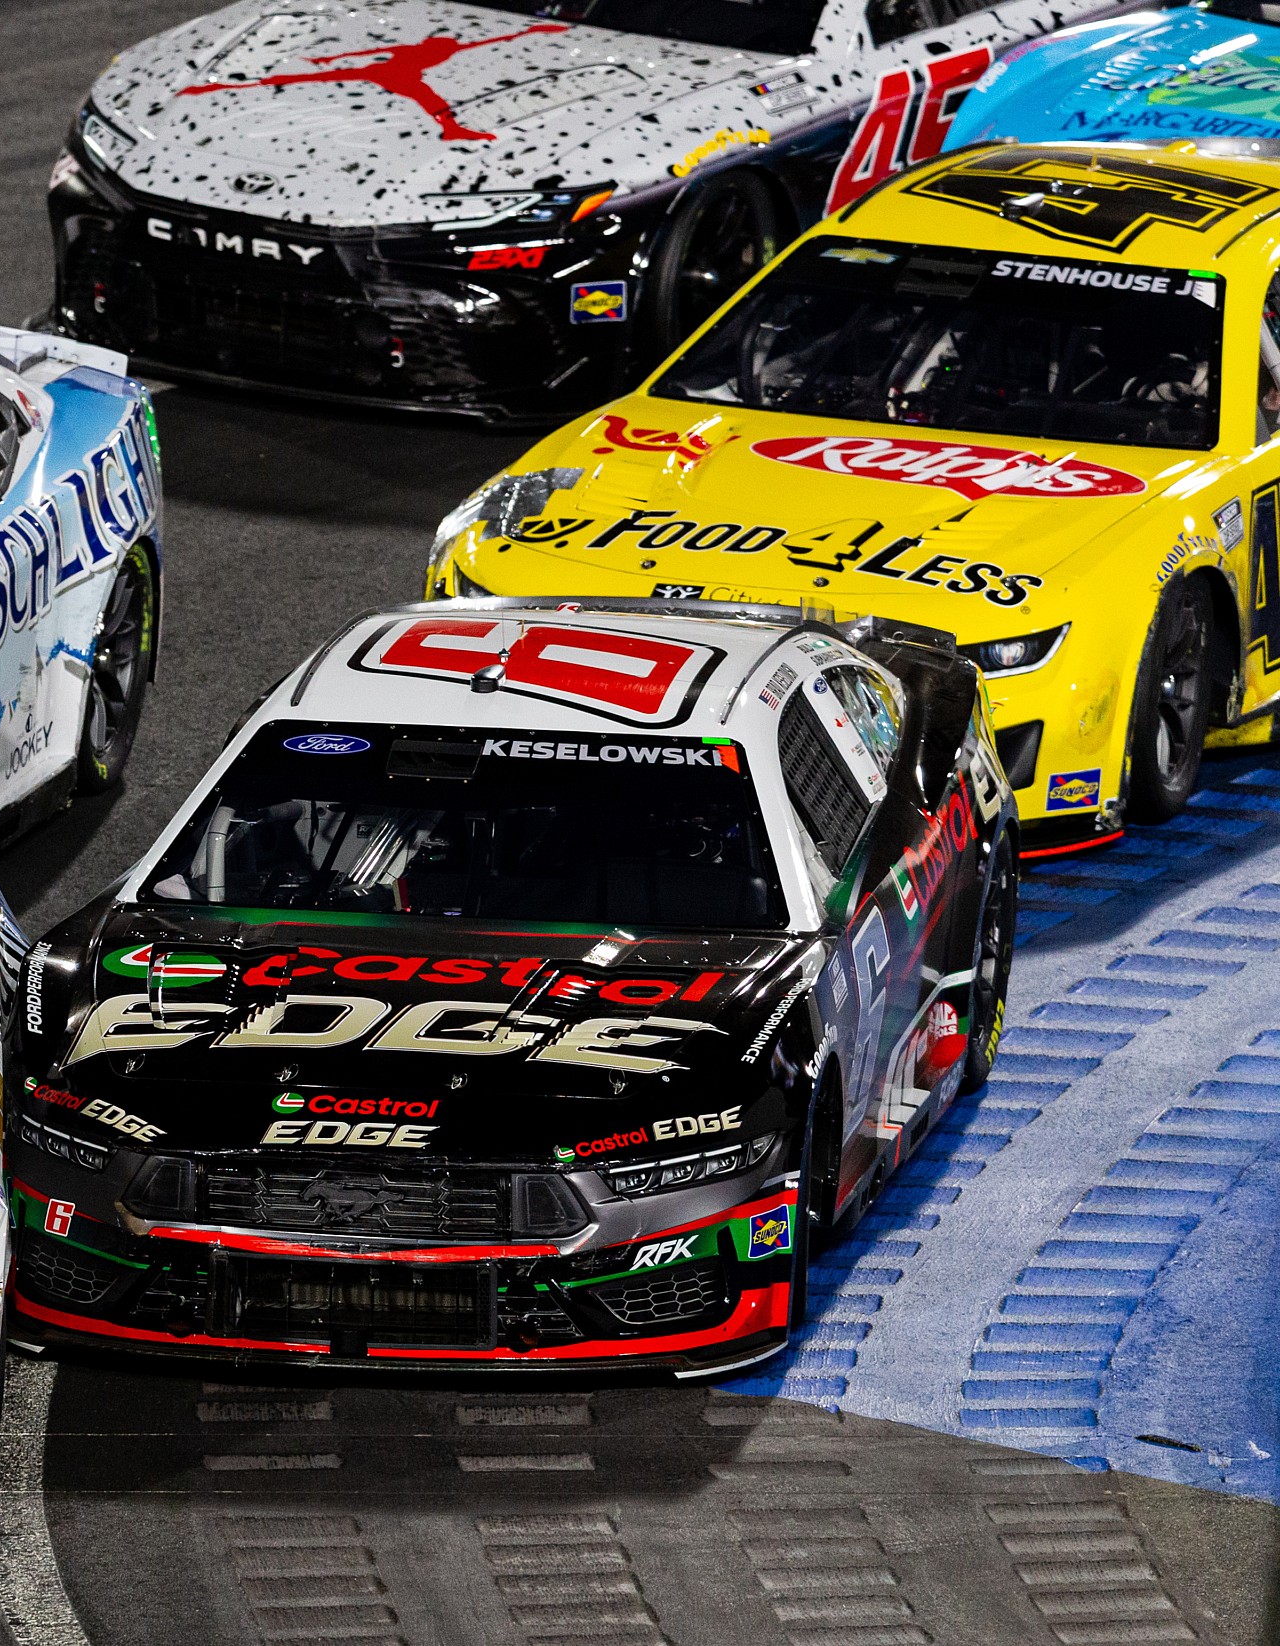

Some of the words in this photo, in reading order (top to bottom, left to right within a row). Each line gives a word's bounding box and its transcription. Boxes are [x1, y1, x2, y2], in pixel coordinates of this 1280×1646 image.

[992, 259, 1170, 295] STENHOUSE
[586, 509, 789, 554] FOOD
[781, 517, 886, 574] 4
[853, 535, 1045, 609] LESS
[5, 720, 53, 780] JOCKEY
[297, 735, 352, 753] Ford
[481, 739, 723, 767] KESELOWSKI
[1051, 784, 1097, 798] SUNOCO
[243, 945, 724, 1003] Castrol
[60, 993, 730, 1074] EDGE
[33, 1083, 84, 1110] Castrol
[79, 1098, 168, 1143] EDGE
[308, 1094, 441, 1118] Castrol
[261, 1120, 441, 1148] EDGE
[575, 1127, 649, 1157] Castrol
[652, 1104, 743, 1142] EDGE
[44, 1198, 76, 1237] 6
[754, 1222, 786, 1244] SUNOCO
[629, 1234, 699, 1271] RFK
